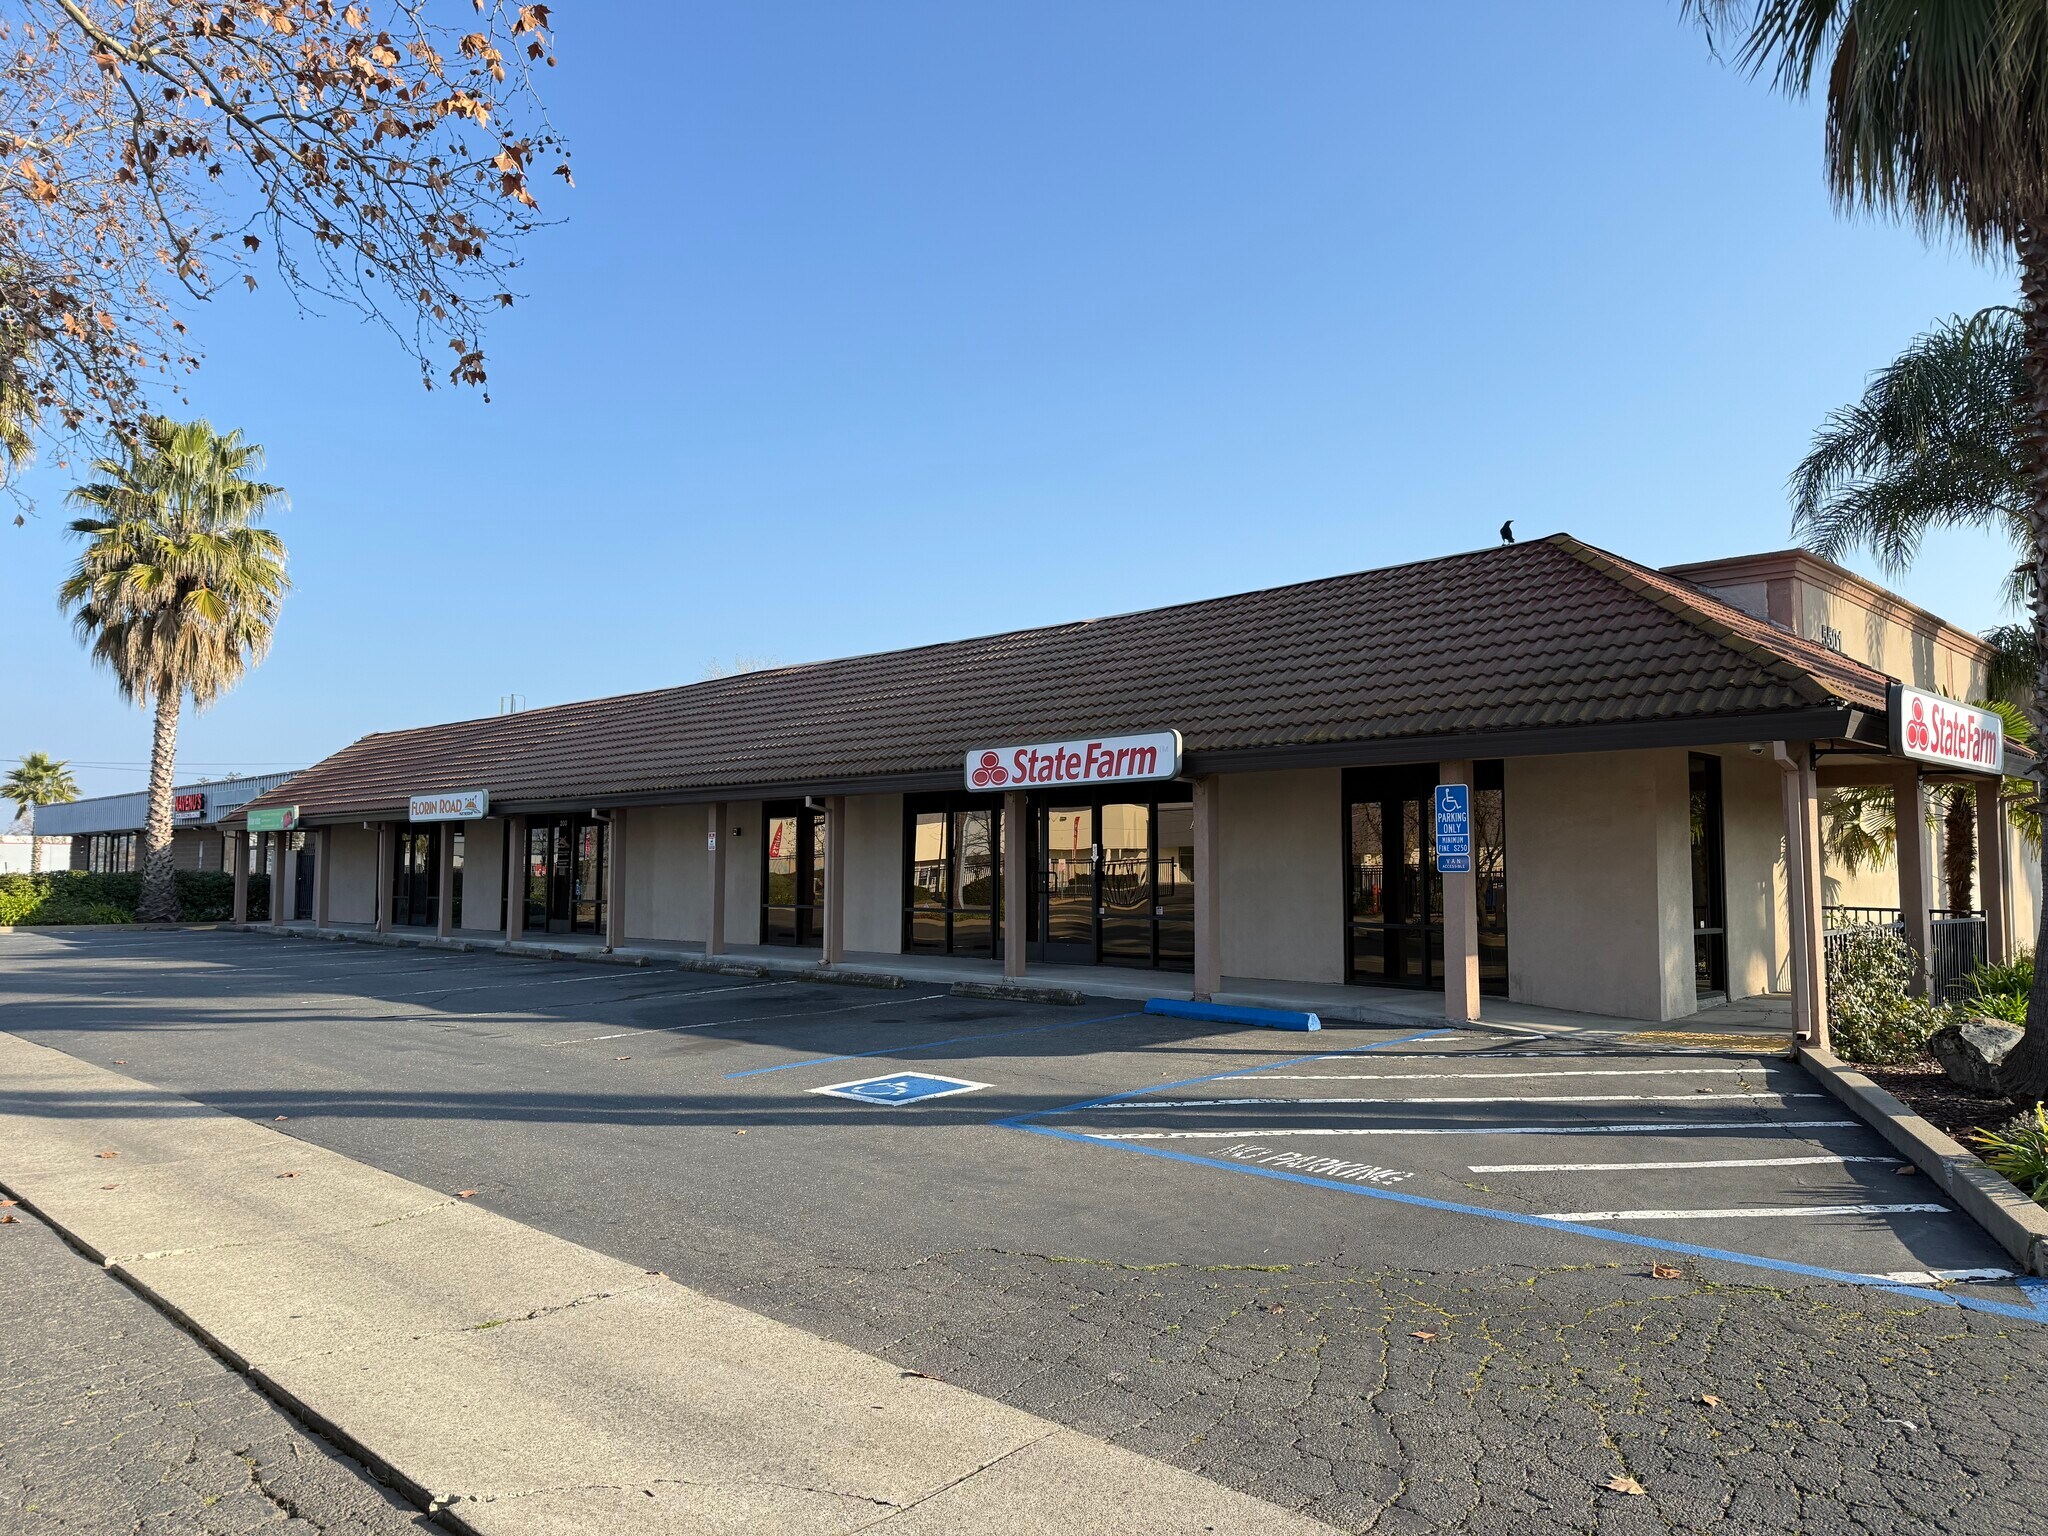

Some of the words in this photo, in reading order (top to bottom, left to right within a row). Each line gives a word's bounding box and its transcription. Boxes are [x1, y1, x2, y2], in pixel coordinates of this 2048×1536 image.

[411, 801, 437, 816] FLORIN
[440, 799, 462, 814] ROAD
[1438, 812, 1467, 823] PARKING
[1443, 823, 1461, 834] ONLY
[1442, 836, 1464, 844] MINIMUM
[1438, 844, 1450, 852] FINE
[1453, 844, 1468, 852] $250
[1209, 1143, 1273, 1160] NO
[1257, 1151, 1416, 1186] PARKING
